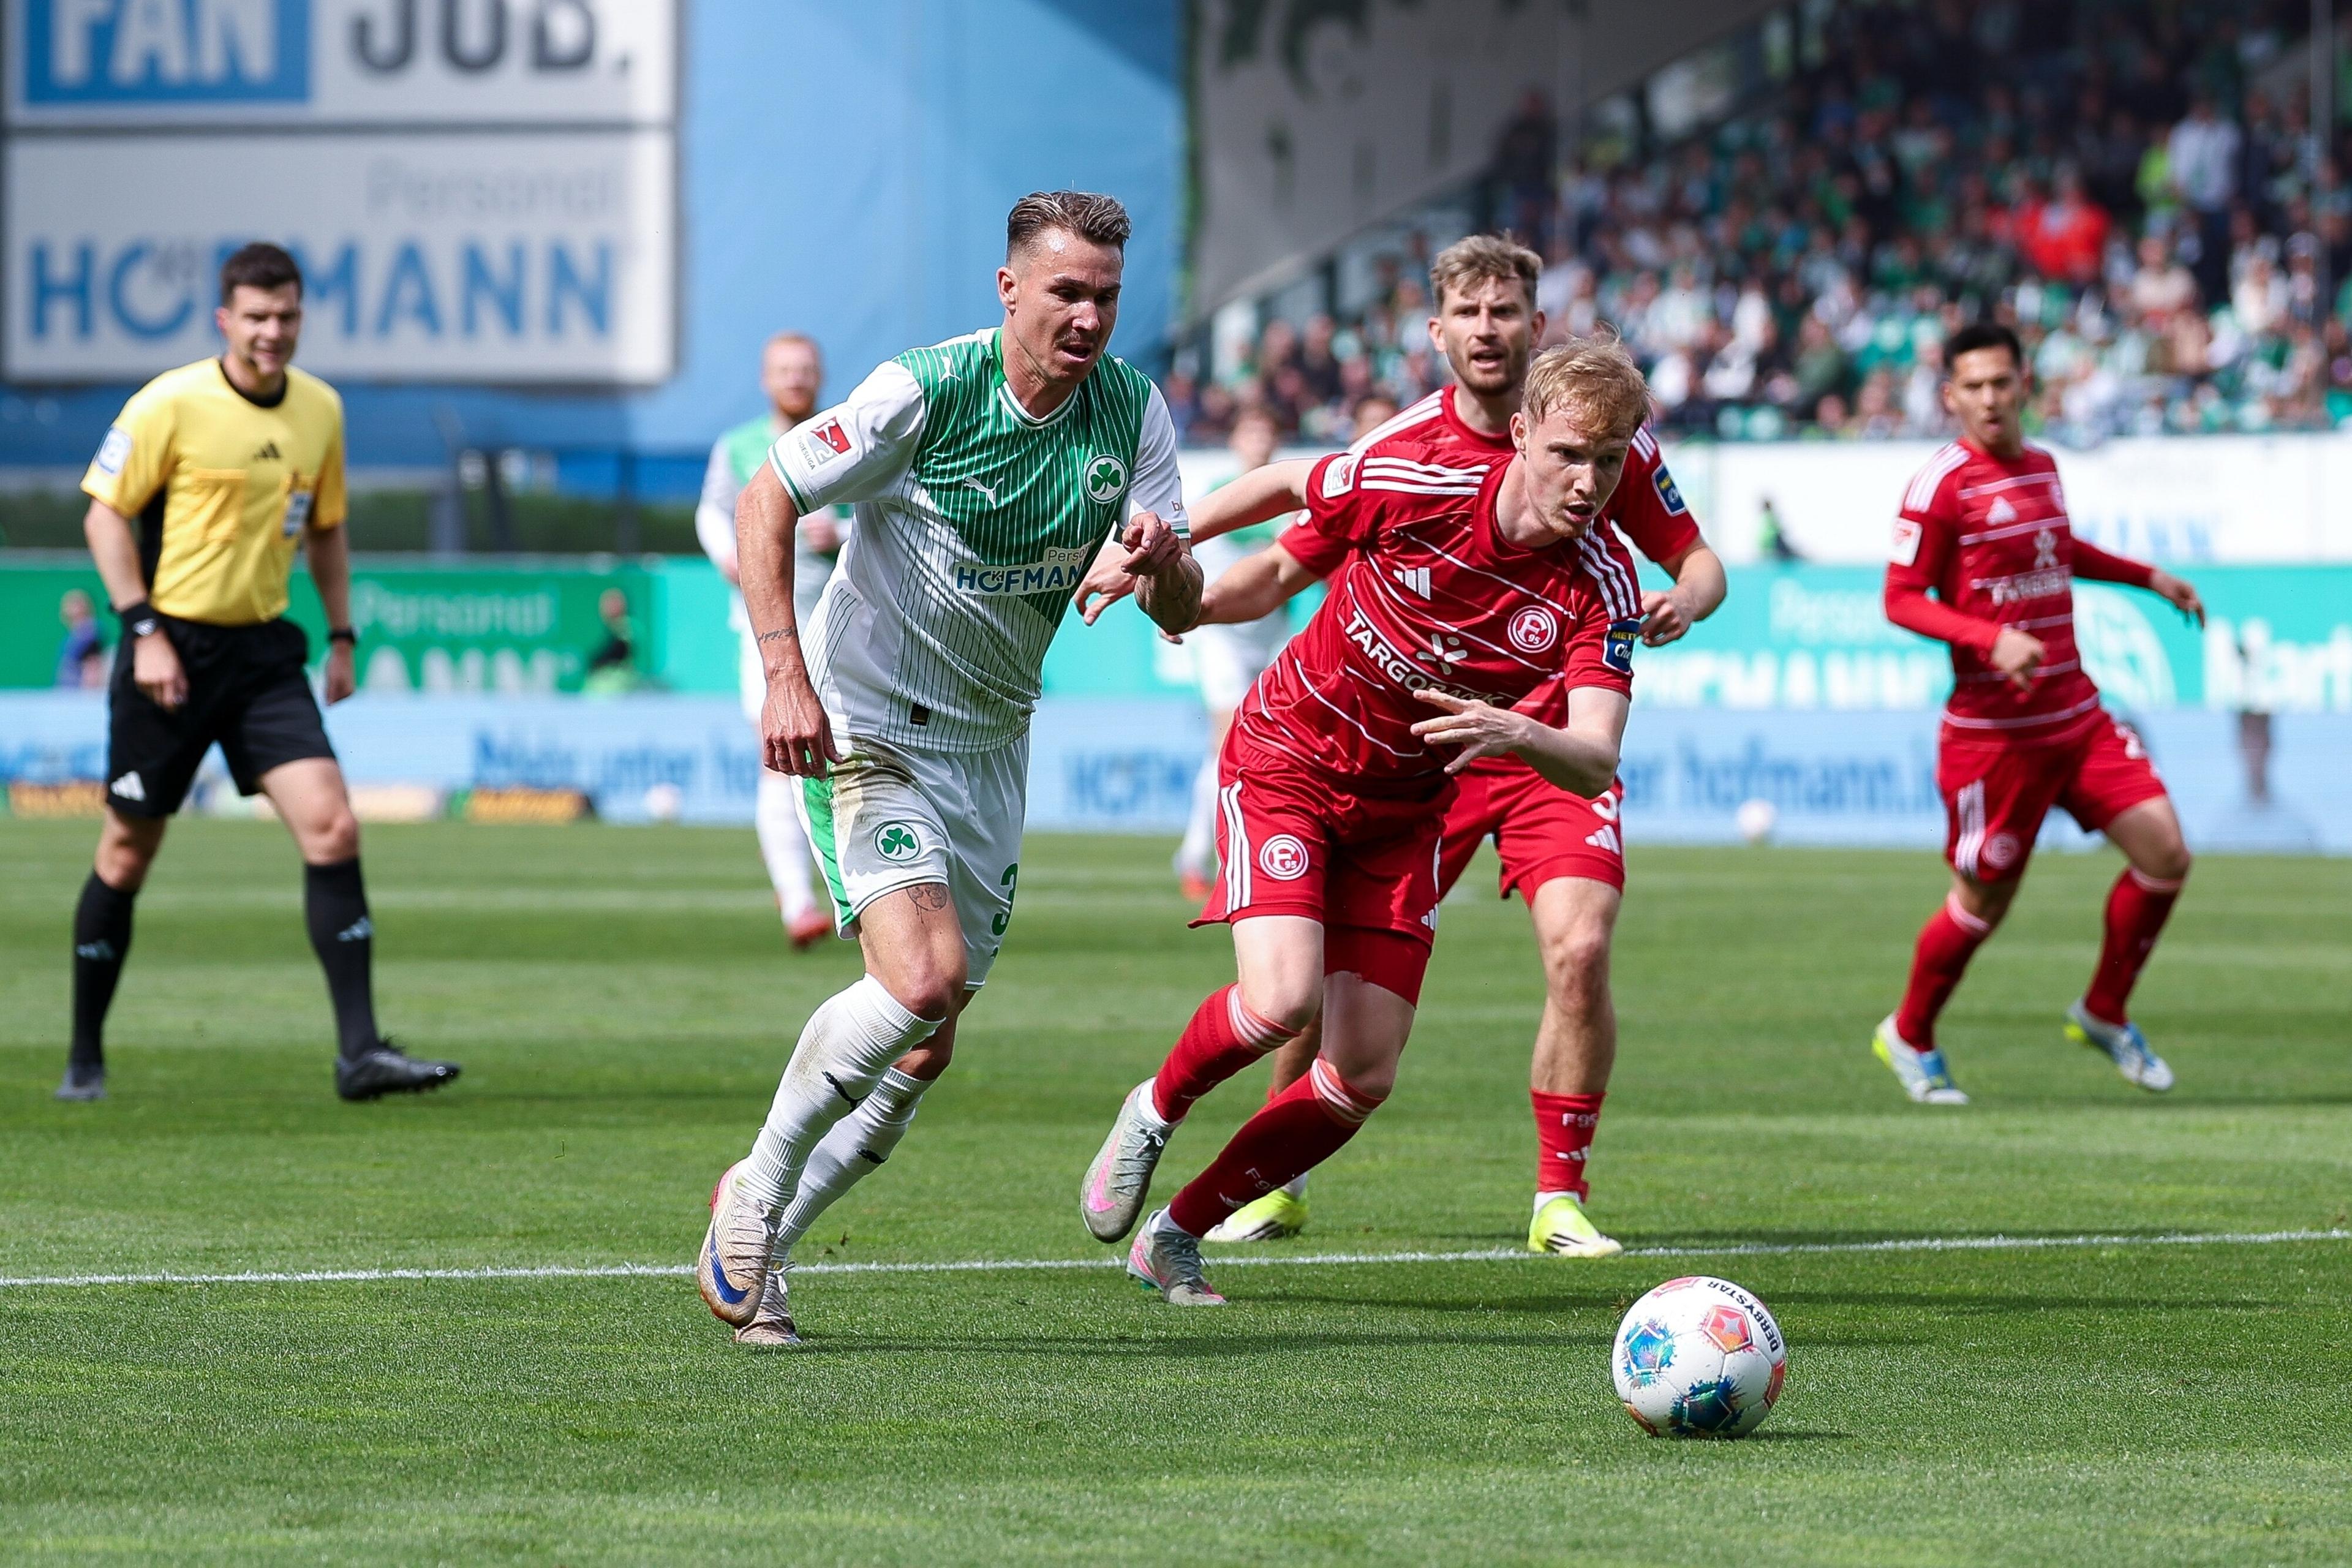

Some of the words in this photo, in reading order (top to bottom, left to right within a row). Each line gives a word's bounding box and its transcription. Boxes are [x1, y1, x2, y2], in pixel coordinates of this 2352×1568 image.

[49, 0, 279, 87] FAN
[957, 560, 1082, 593] HOFMAN
[1047, 540, 1096, 562] Perso
[1708, 1281, 1779, 1353] DERBYSTAR
